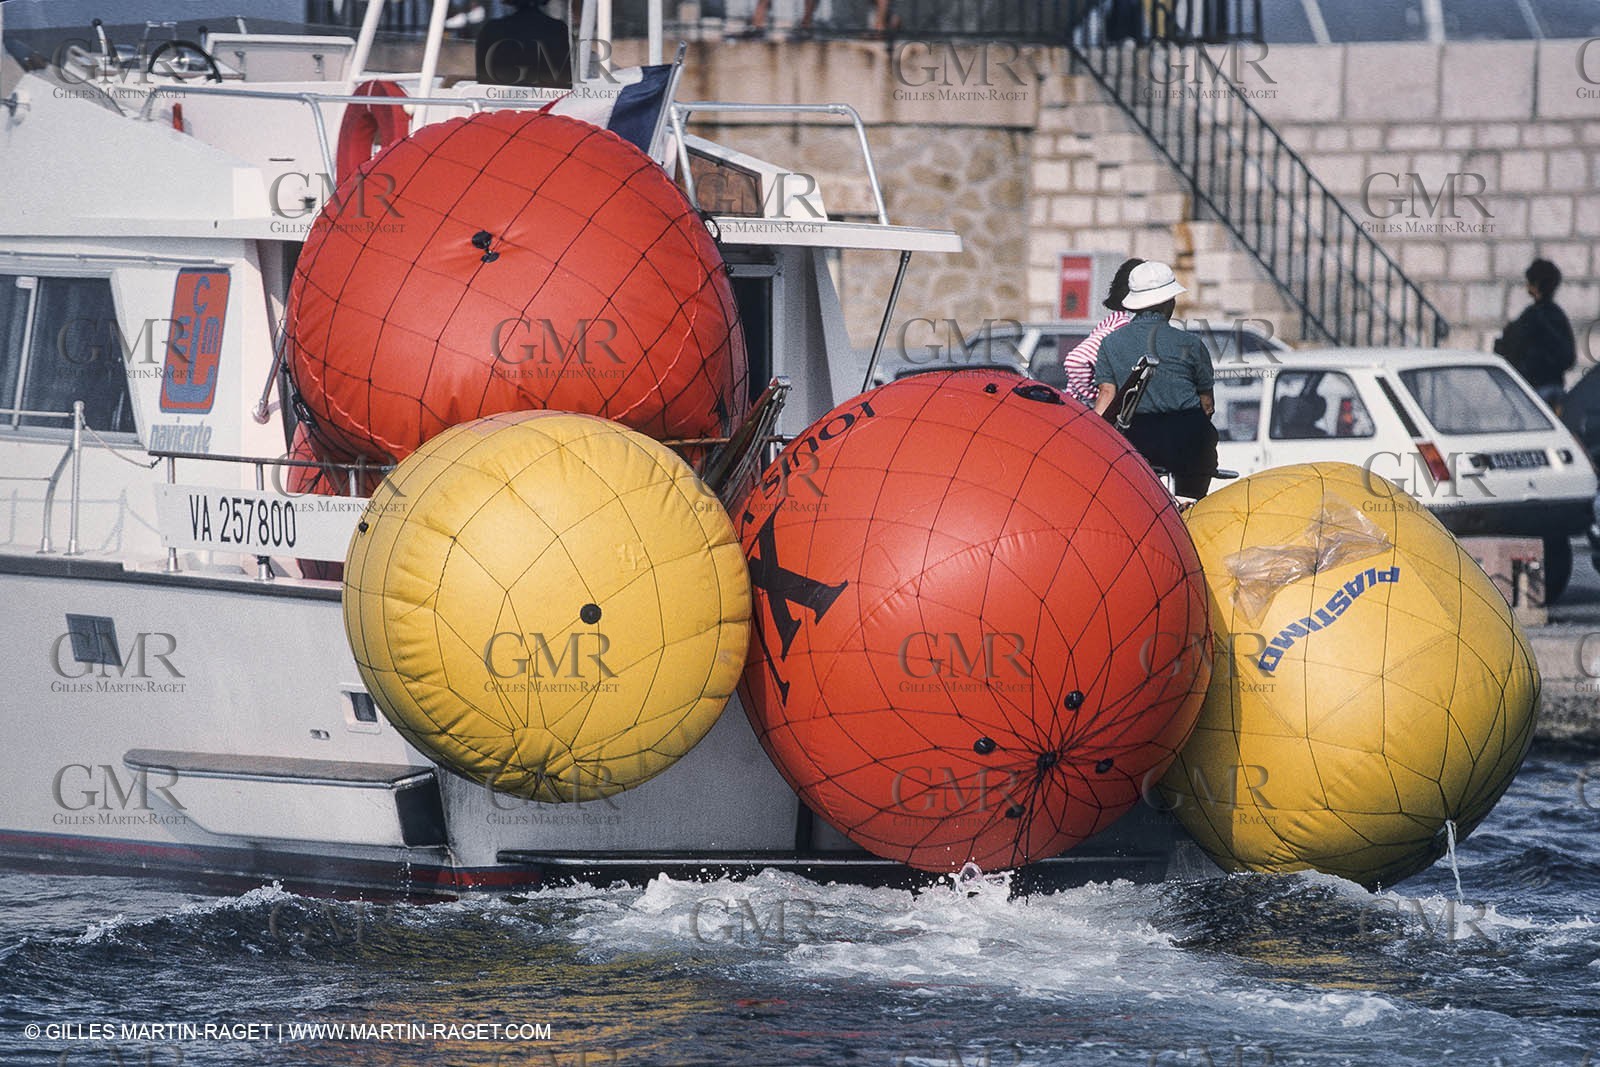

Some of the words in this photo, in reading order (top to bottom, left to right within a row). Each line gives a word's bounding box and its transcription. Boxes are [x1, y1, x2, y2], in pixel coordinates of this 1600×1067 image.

[189, 495, 212, 541] VA
[219, 496, 296, 548] 257800
[1258, 566, 1400, 672] PLASTIMO
